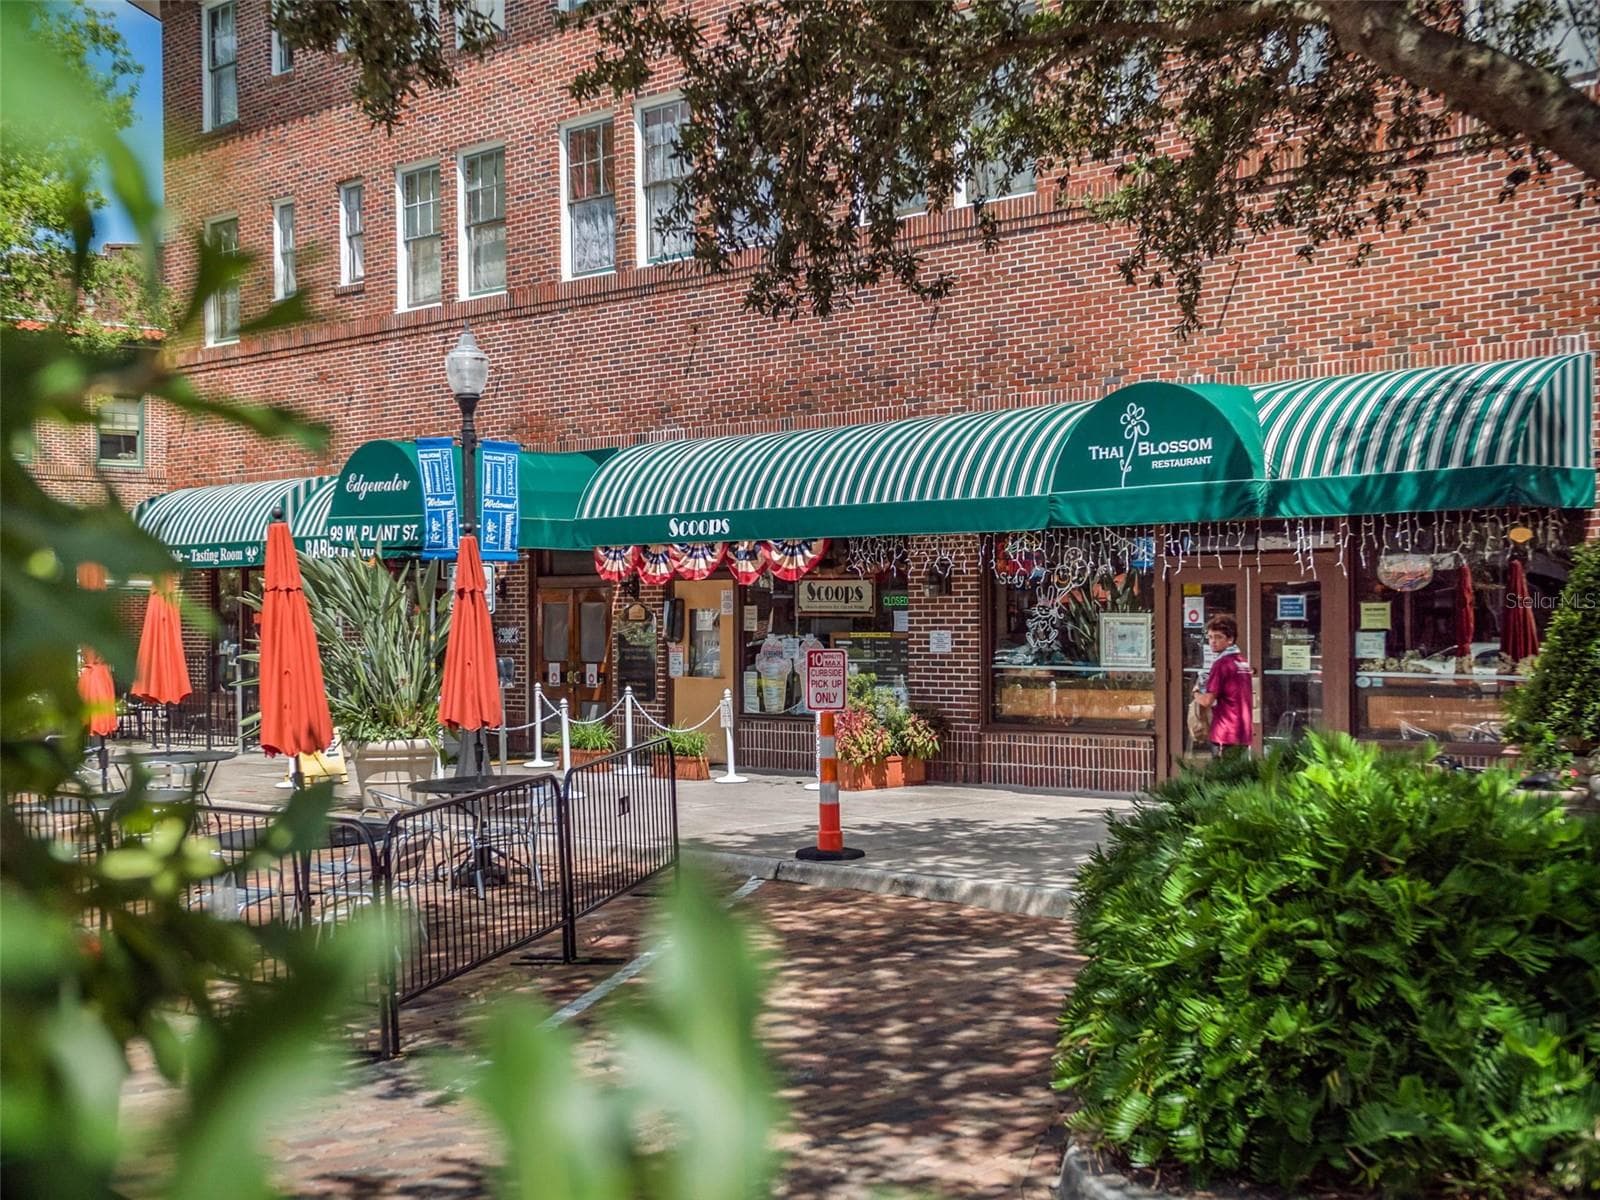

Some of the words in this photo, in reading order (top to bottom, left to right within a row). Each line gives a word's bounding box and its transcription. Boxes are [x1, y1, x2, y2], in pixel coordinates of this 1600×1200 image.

[1151, 456, 1213, 469] RESTAURANT
[346, 472, 411, 501] Edgewater
[330, 525, 343, 541] 99
[361, 525, 400, 541] PLANT
[402, 524, 419, 540] ST.
[668, 517, 730, 537] Scoops
[191, 548, 220, 565] Tasting
[220, 548, 243, 561] Room
[806, 581, 864, 604] Scoops
[882, 595, 910, 606] CLOSED
[809, 653, 823, 666] 10
[811, 669, 842, 677] CURBSIDE
[811, 680, 829, 688] PICK
[831, 680, 842, 688] UP
[815, 692, 838, 703] ONLY
